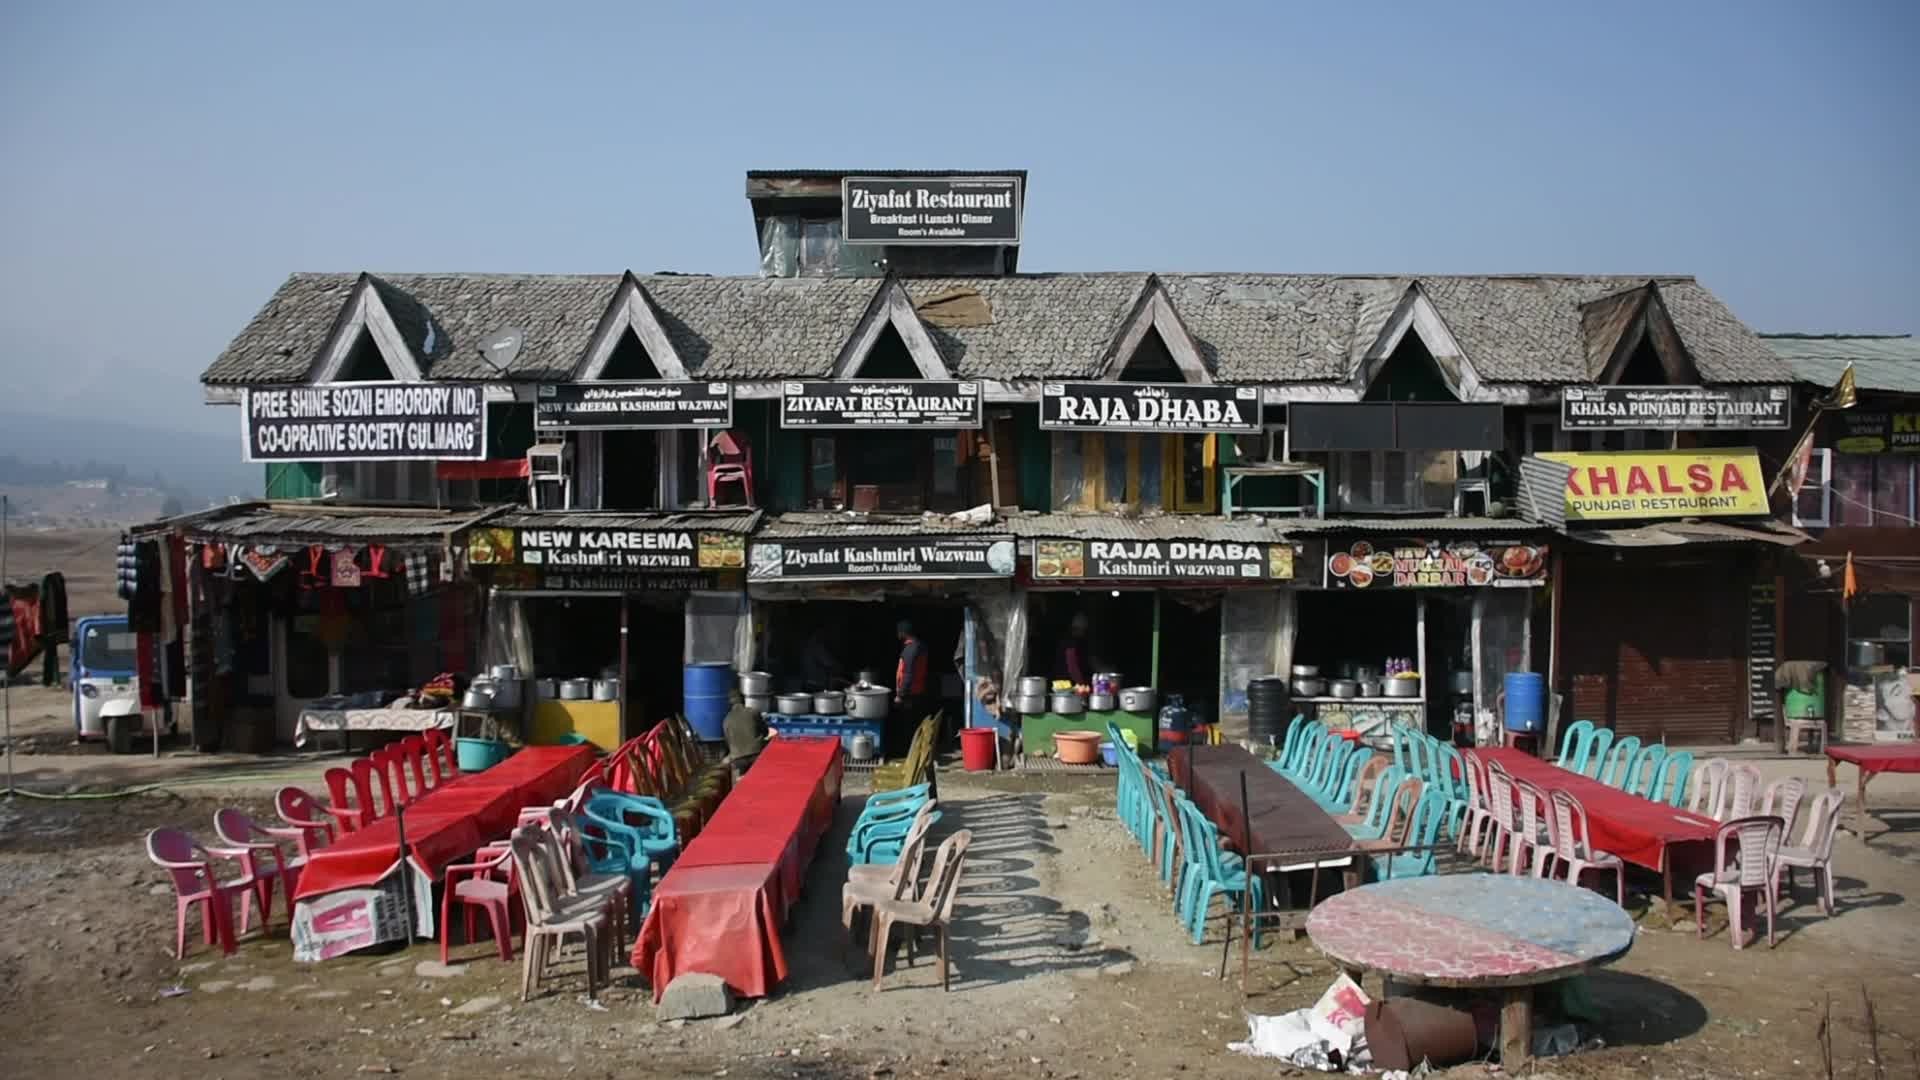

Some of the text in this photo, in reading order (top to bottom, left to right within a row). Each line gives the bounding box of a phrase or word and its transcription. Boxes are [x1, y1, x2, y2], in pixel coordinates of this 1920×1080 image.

[852, 188, 1012, 212] Ziyafat Restaurant
[870, 213, 917, 224] Breakfast
[925, 214, 954, 224] Lunch
[961, 214, 993, 224] Dinner
[928, 228, 966, 236] Available
[252, 391, 288, 418] PREE
[290, 390, 330, 417] SHINE
[333, 389, 372, 416] SOZNI
[375, 388, 450, 415] EMBORDRY
[538, 400, 728, 413] NEW KAREEMA KASHMIRI WAZWAN
[786, 396, 975, 412] ZIYAFAT RESTAURANT
[1059, 396, 1243, 425] RAJA DHABA
[1571, 401, 1783, 418] KHALSA PUNJABI RESTAURANT
[258, 421, 473, 452] CO-OPRATIVE SOCIETY GULMARG
[1568, 463, 1749, 496] KHALSA
[1573, 496, 1738, 512] PUNJABI RESTAURANT
[521, 531, 693, 549] NEW KAREEMA
[785, 547, 985, 568] Ziyafat Kashmiri Wazwan
[1091, 542, 1263, 560] RAJA DHABA
[626, 553, 690, 567] wazwan
[848, 563, 923, 573] Room's Available
[1098, 560, 1235, 576] Kashmiri wazwan
[1394, 572, 1466, 587] DARBAR
